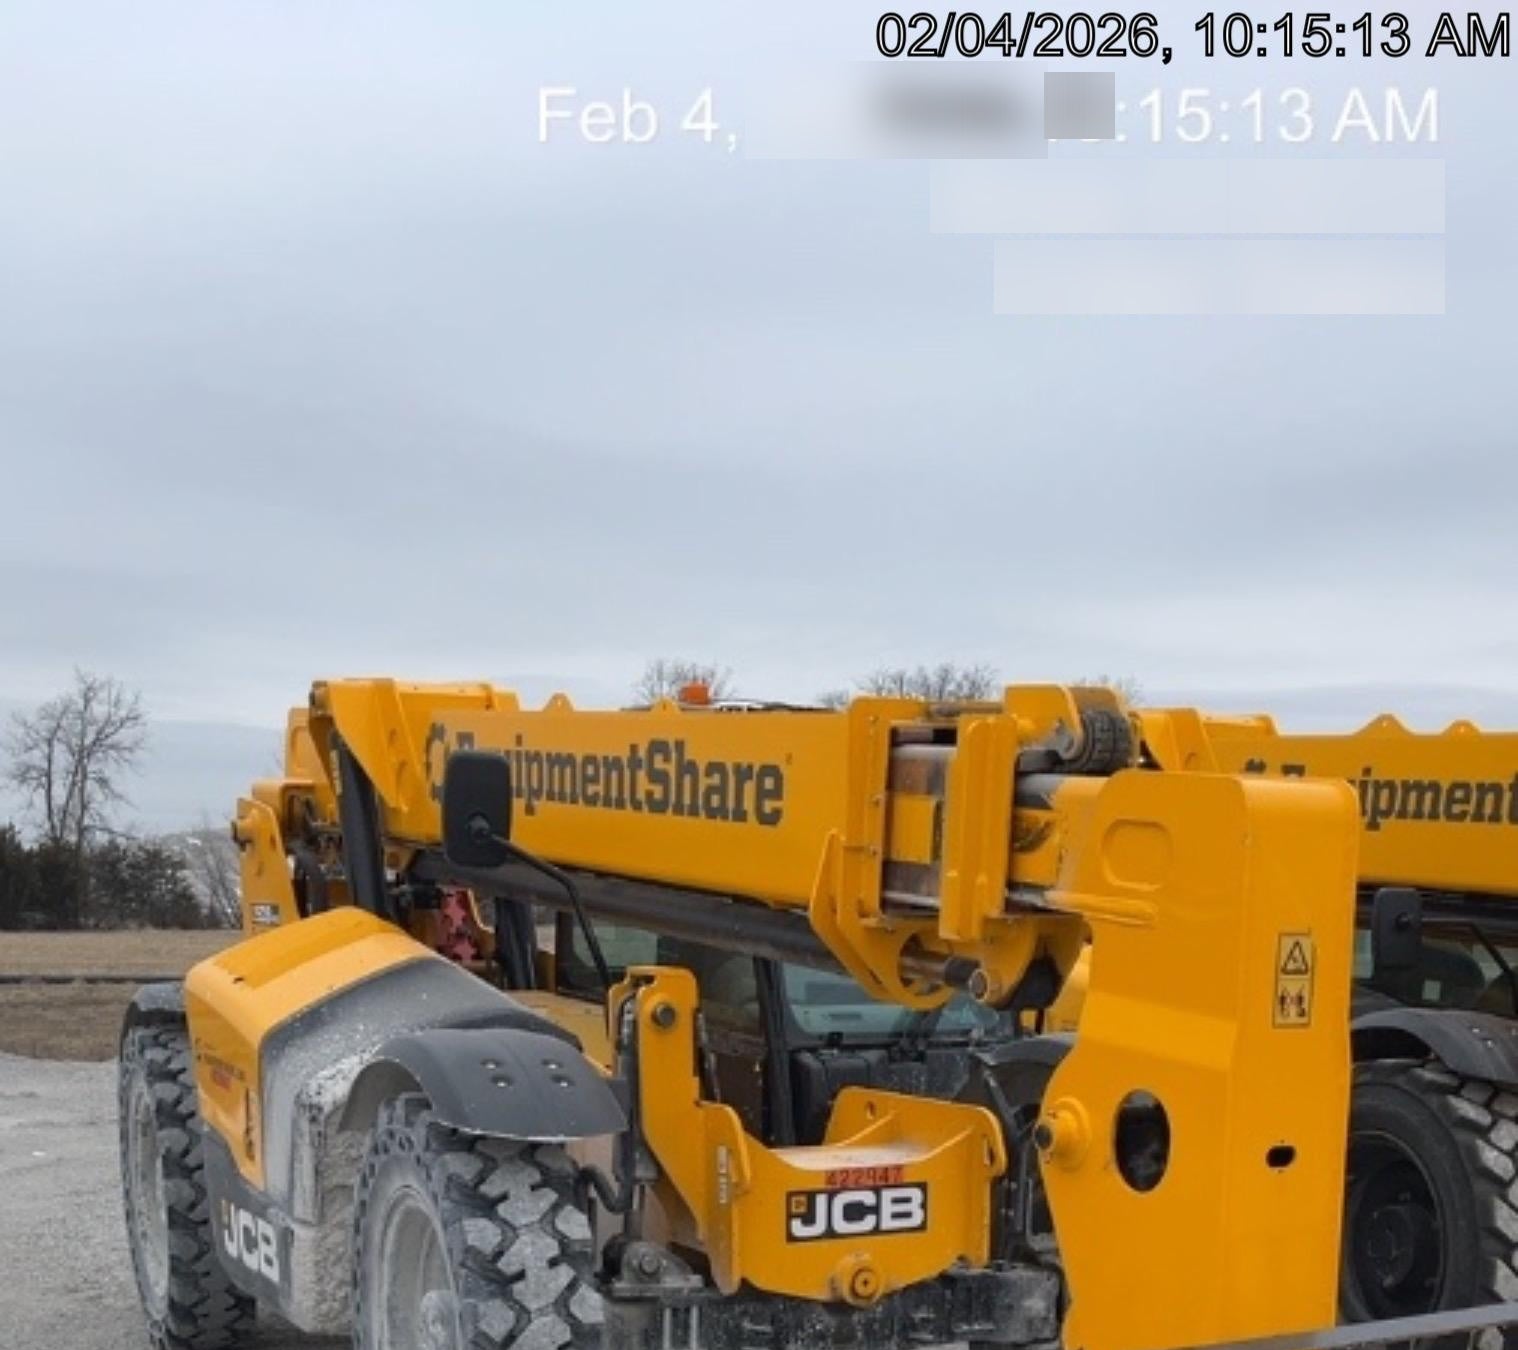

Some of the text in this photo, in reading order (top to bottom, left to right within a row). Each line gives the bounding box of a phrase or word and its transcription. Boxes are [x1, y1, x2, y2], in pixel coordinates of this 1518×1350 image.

[456, 731, 783, 827] ipmentShare
[224, 1203, 280, 1283] JCB
[790, 1187, 925, 1238] JCB
